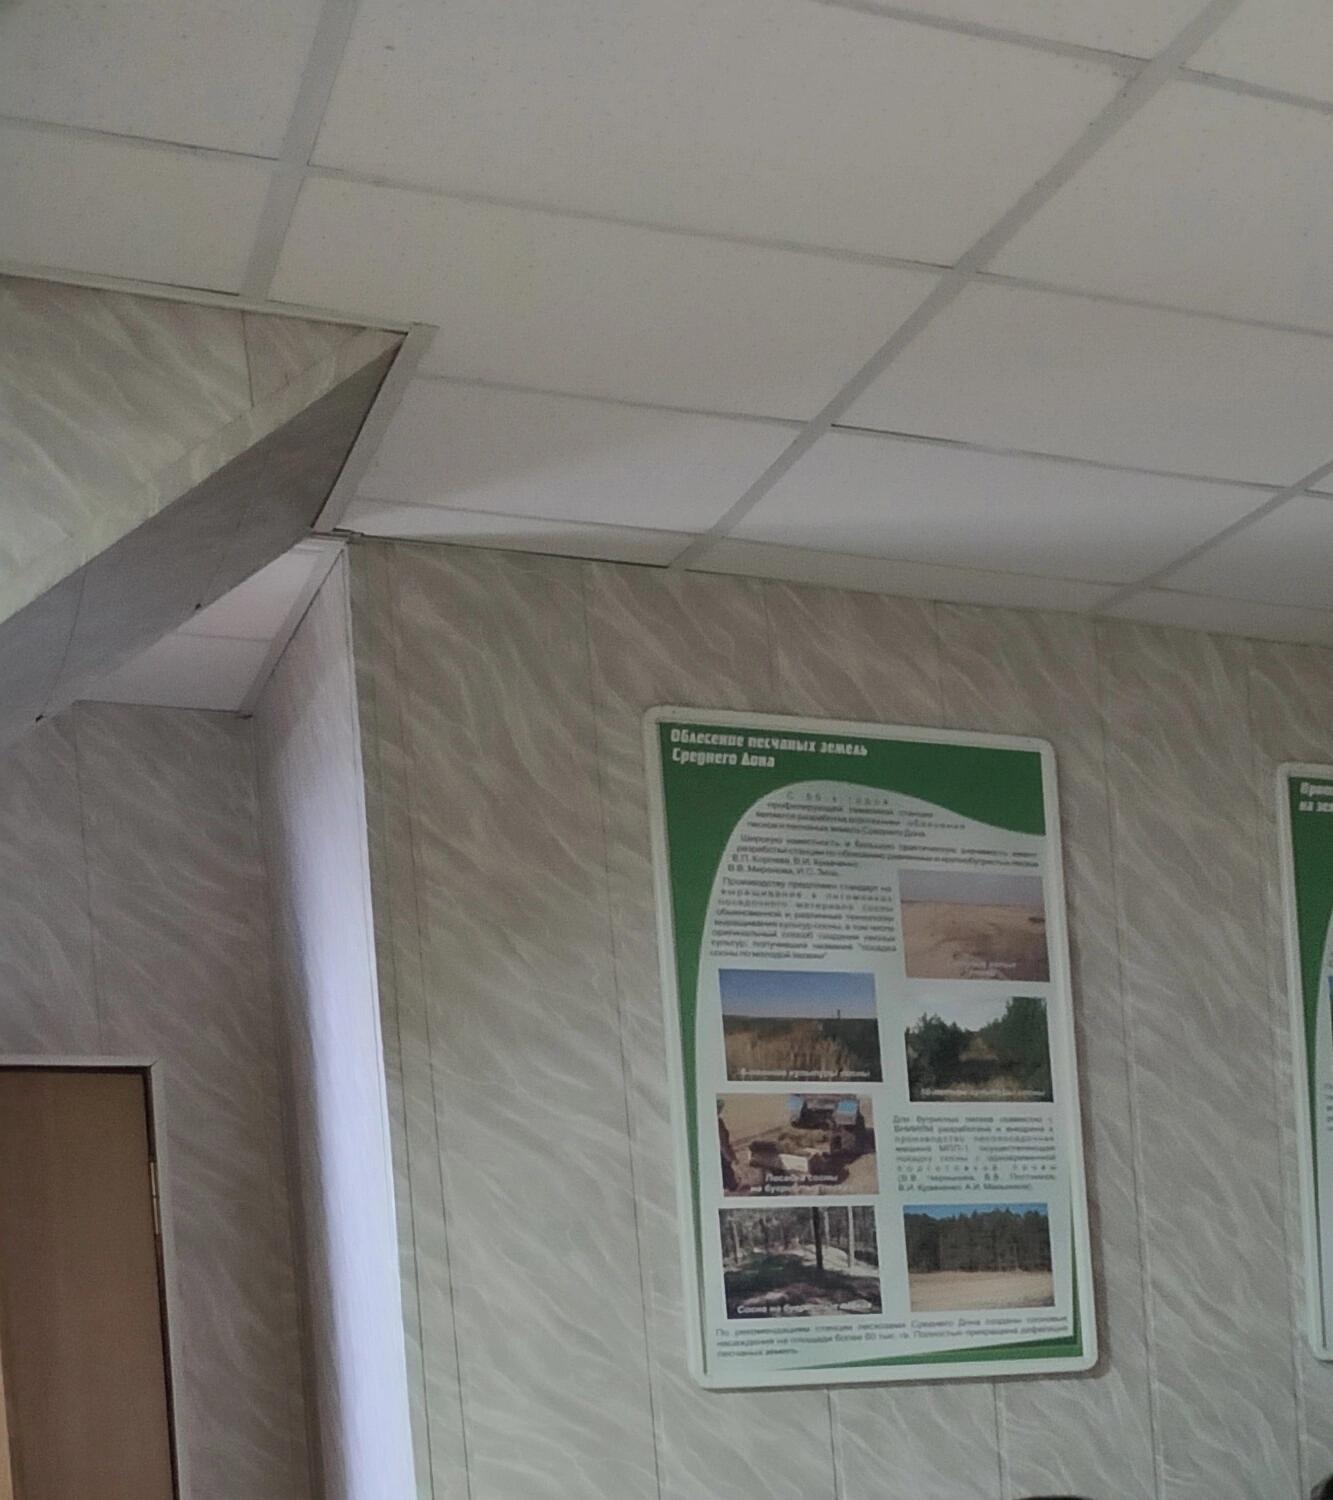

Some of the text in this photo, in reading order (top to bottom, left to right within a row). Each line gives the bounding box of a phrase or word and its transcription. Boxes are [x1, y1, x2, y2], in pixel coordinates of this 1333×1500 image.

[670, 728, 867, 756] Облесение песчаных земель
[671, 747, 774, 767] Среднего Дона
